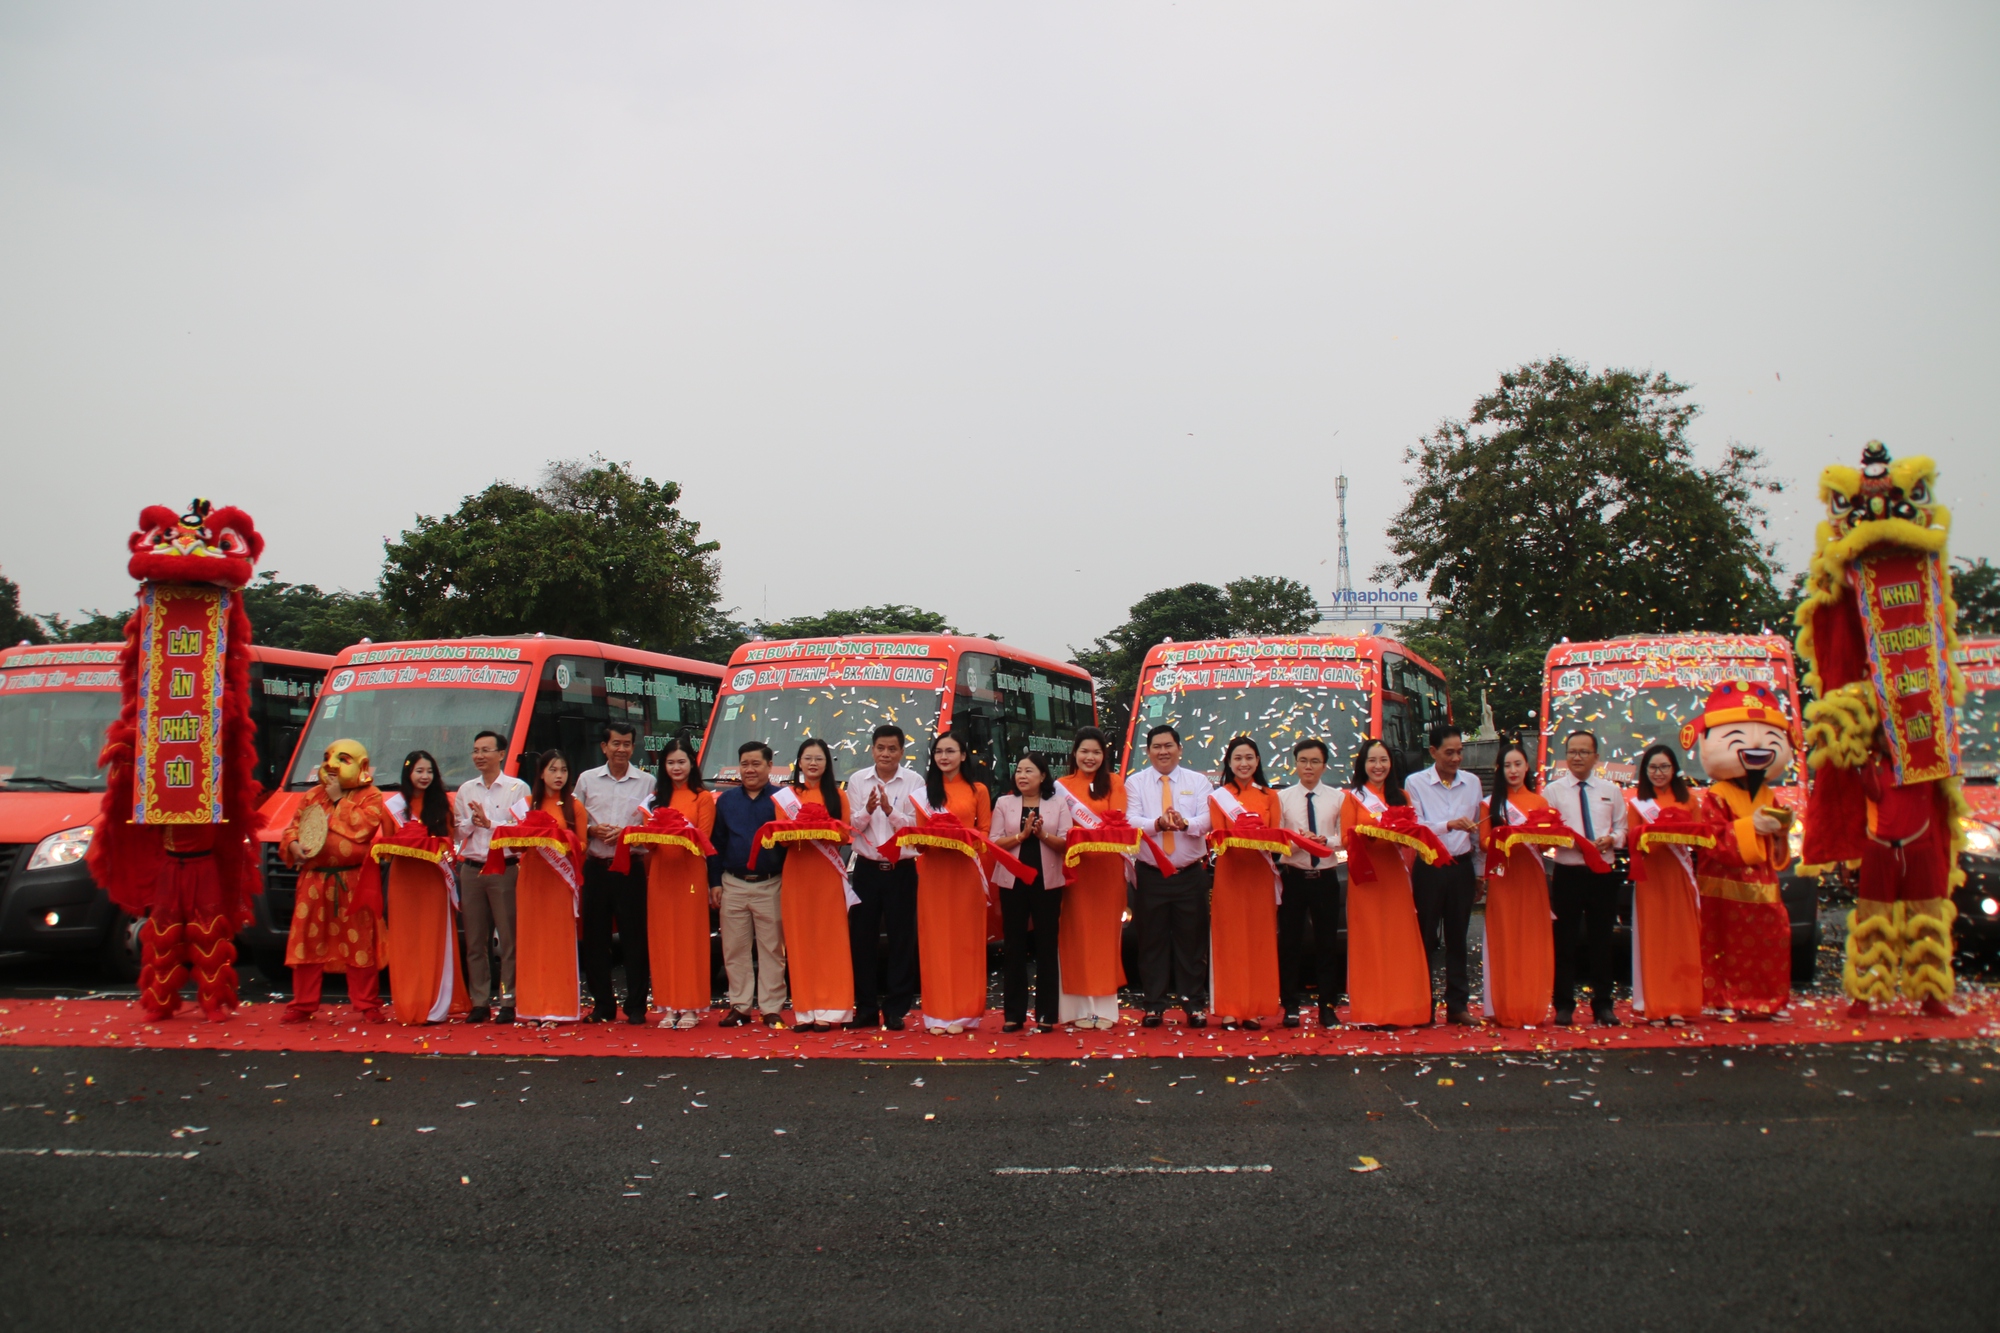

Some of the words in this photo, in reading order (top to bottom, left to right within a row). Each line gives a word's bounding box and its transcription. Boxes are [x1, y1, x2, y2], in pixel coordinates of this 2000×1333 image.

[1332, 588, 1418, 604] vinaphone
[1879, 581, 1921, 609] KHAI
[168, 626, 201, 656] LÀM
[745, 648, 765, 661] XE
[766, 643, 804, 659] BUÝT
[805, 641, 872, 657] PHƯƠNG
[872, 643, 929, 656] TRANG
[2, 654, 20, 668] XE
[20, 651, 56, 666] BUÝT
[55, 649, 117, 664] PHƯƠNG
[349, 652, 367, 665] XE
[367, 649, 404, 663] BUÝT
[404, 646, 468, 660] PHƯƠNG
[469, 647, 520, 660] TRANG
[1165, 650, 1184, 663] XE
[1300, 644, 1356, 658] TRANG
[1570, 651, 1587, 664] XE
[334, 672, 353, 687] 951
[356, 673, 369, 686] TT
[369, 668, 395, 685] BÚNG
[396, 666, 418, 684] TÀU
[493, 669, 519, 685] THƠ
[733, 672, 755, 687] 9515
[788, 667, 828, 682] THANH
[863, 664, 891, 681] KIÊN
[893, 668, 933, 683] GIANG
[1213, 668, 1253, 683] THANH
[1290, 663, 1319, 682] KIÊN
[1322, 667, 1363, 683] GIANG
[1561, 674, 1582, 688] 951
[170, 668, 194, 699] ĂN
[159, 711, 201, 743] PHÁT
[644, 736, 655, 751] XE
[165, 755, 193, 787] TÀI
